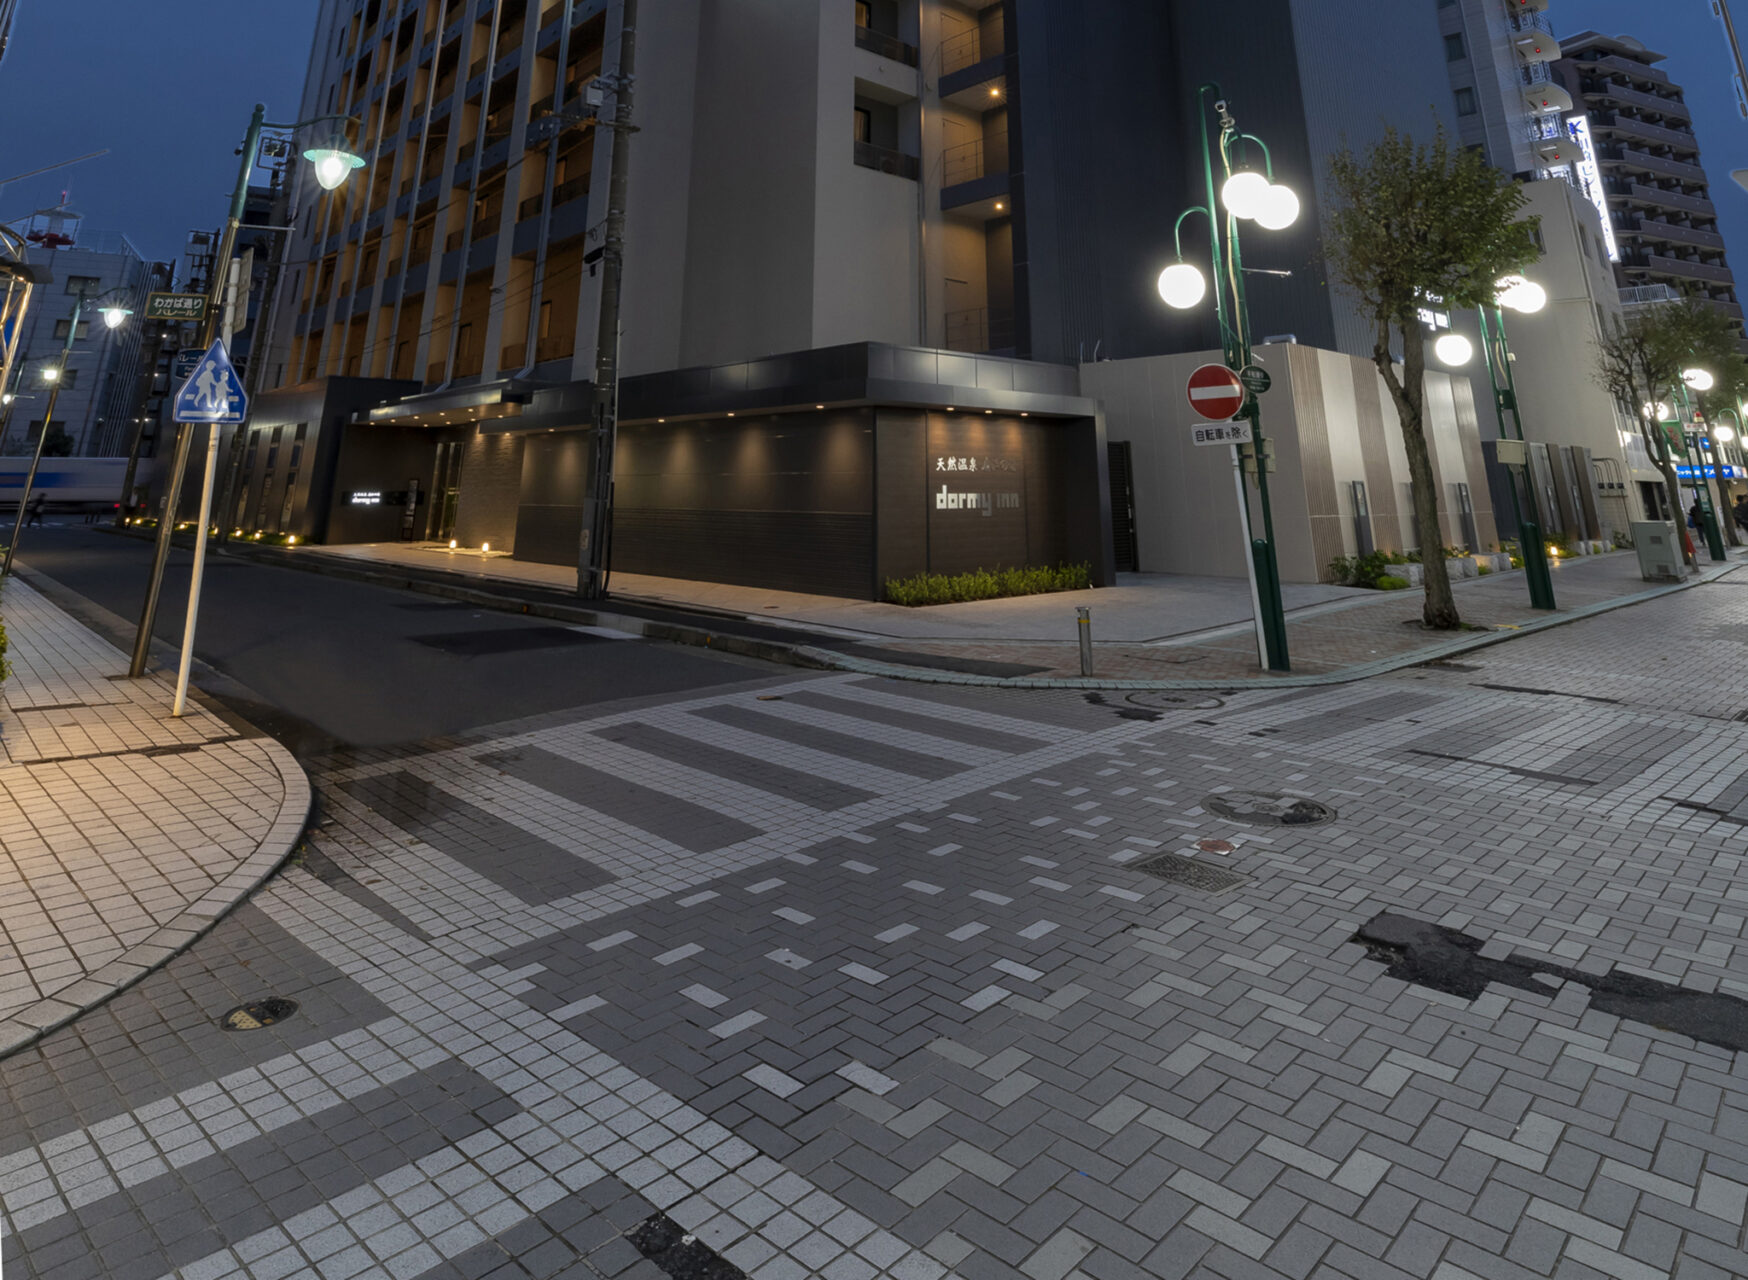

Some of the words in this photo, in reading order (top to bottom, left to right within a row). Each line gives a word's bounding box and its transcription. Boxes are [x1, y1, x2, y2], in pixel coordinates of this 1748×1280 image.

[153, 297, 203, 310] わかば通り
[1195, 427, 1249, 442] 自転車を除く
[936, 456, 978, 473] 天然温泉
[936, 484, 993, 517] dormy
[996, 492, 1020, 509] inn
